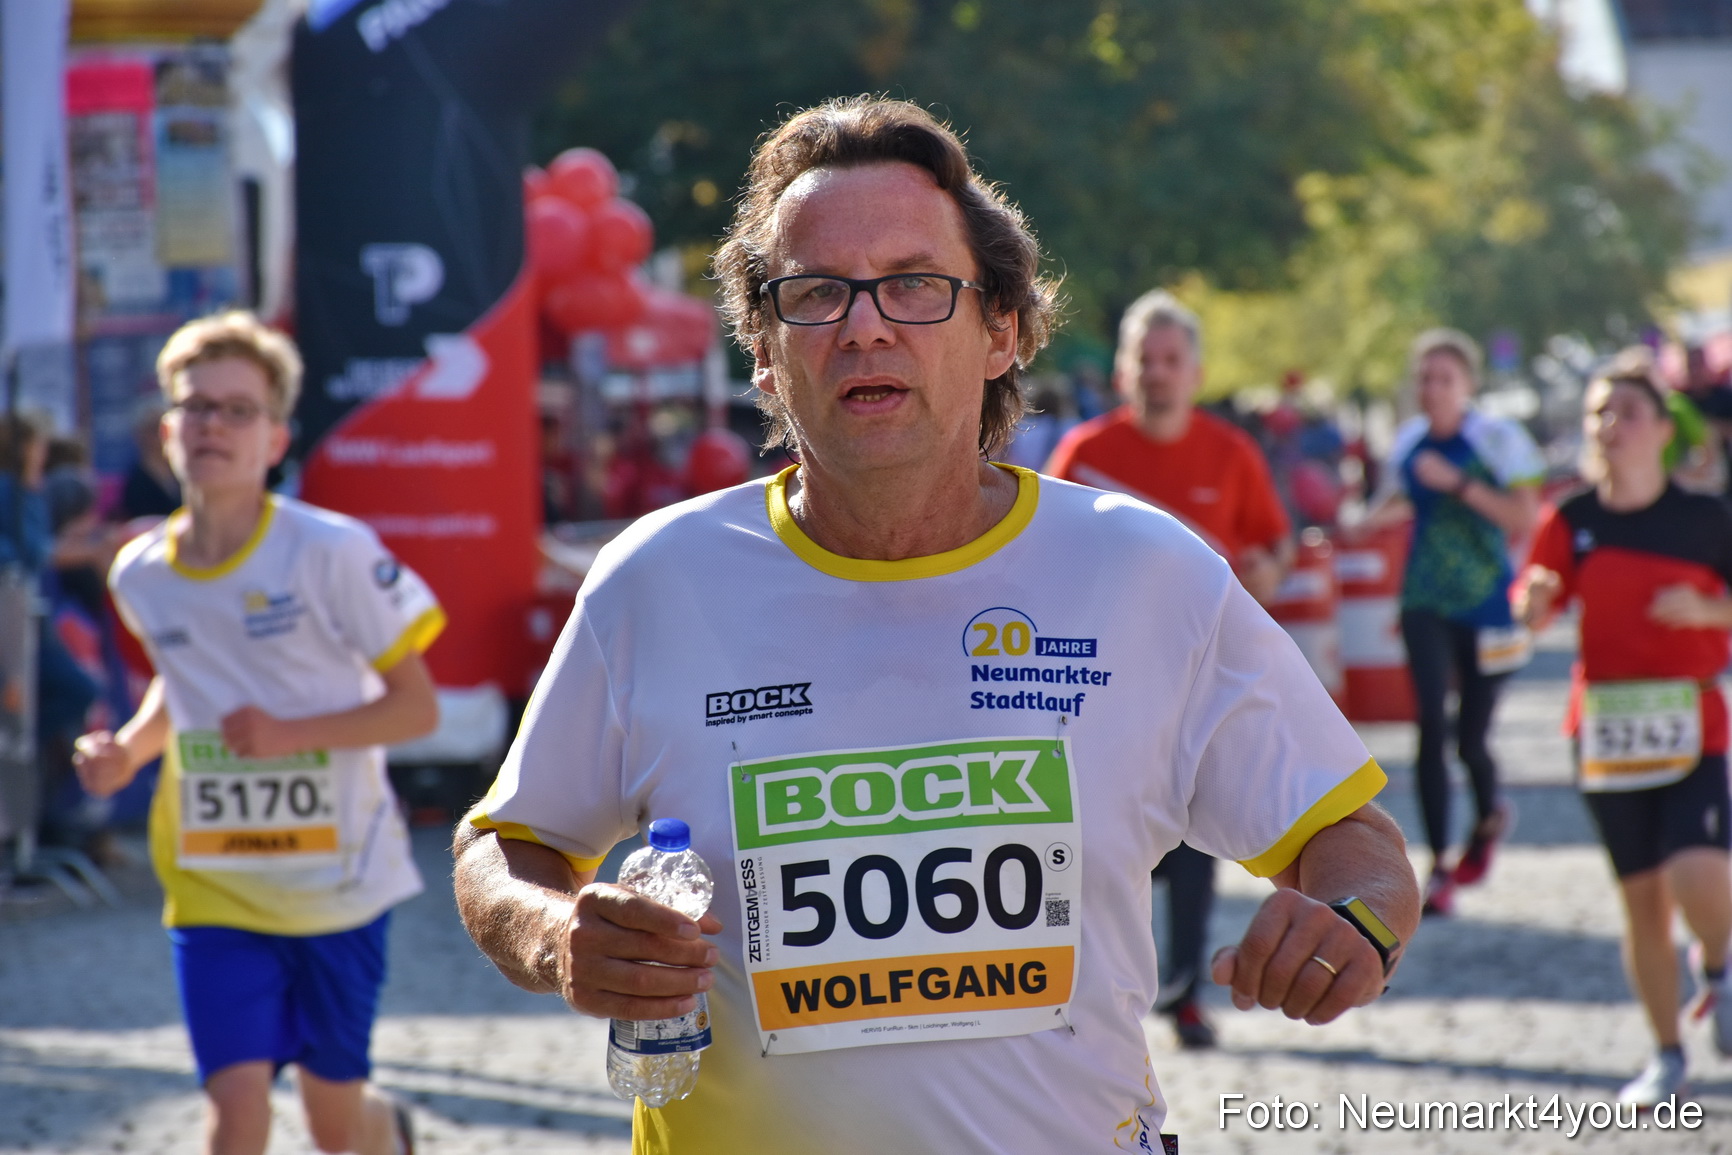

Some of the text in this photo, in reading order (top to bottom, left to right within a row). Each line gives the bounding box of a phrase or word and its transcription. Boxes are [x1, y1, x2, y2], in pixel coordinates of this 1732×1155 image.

[972, 621, 1092, 656] 20 JAHRE
[971, 664, 1112, 686] Neumarkter
[705, 707, 814, 727] inspired by smart concepts
[706, 682, 813, 718] BOCK
[970, 691, 1086, 717] Stadtlauf
[197, 777, 319, 821] 5170
[755, 750, 1051, 836] BOCK
[1052, 848, 1066, 865] S
[757, 856, 771, 961] TRANSPONDER ZEITMESSUNG
[780, 843, 1043, 947] 5060
[780, 961, 1048, 1015] WOLFGANG
